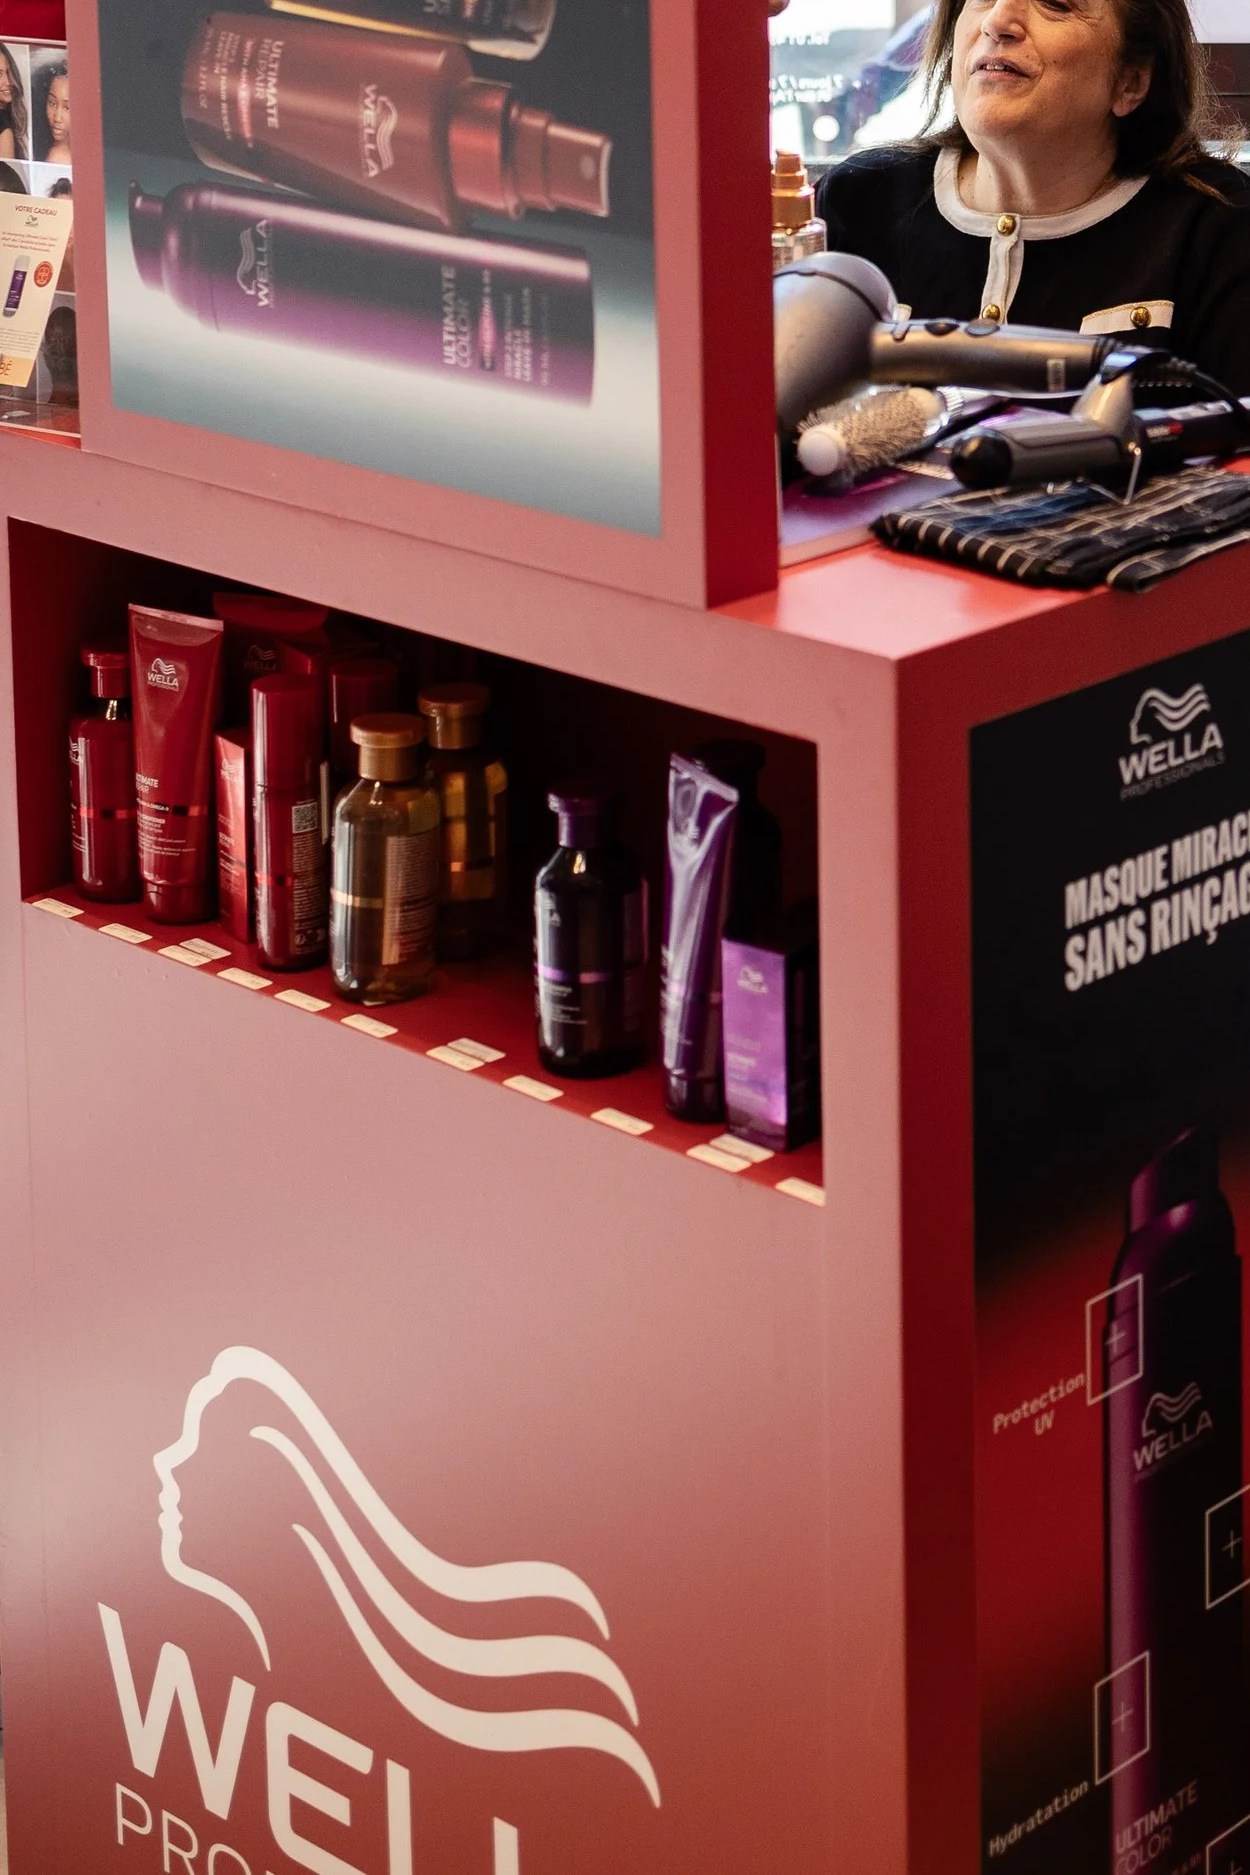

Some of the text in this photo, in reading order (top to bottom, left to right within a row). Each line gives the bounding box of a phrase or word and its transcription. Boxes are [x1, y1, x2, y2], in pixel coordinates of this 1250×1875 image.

[254, 38, 273, 99] REPAIR
[266, 40, 285, 129] ULTIMATE
[364, 84, 380, 177] WELLA
[15, 205, 57, 216] VOTRE CADEAU
[256, 219, 270, 306] WELLA
[441, 265, 456, 365] ULTIMATE
[148, 672, 179, 686] WELLA
[1118, 723, 1224, 785] WELLA
[1119, 751, 1226, 801] PROFESSIONALS
[1065, 845, 1169, 929] MASQUE
[1064, 909, 1146, 991] SANS
[993, 1373, 1084, 1434] Protection
[1034, 1410, 1055, 1435] UV
[1133, 1410, 1213, 1471] WELLA
[988, 1781, 1089, 1858] Hydratation
[1115, 1780, 1198, 1853] ULTIMATE
